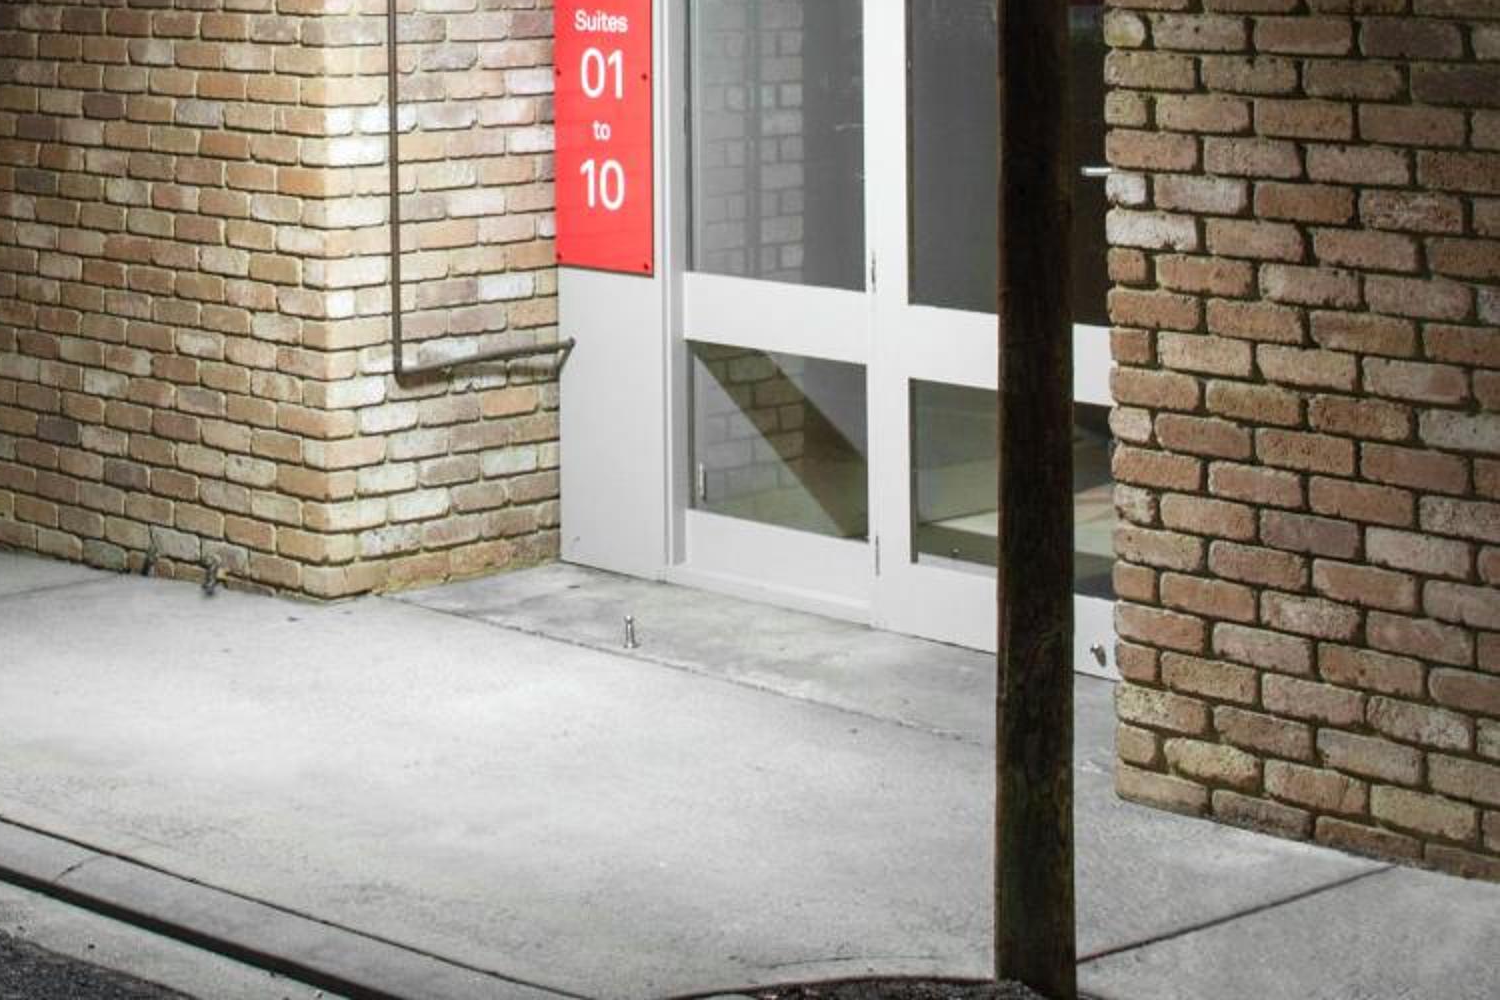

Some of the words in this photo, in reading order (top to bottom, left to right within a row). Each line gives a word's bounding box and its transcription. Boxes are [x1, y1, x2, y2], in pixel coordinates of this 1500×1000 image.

[574, 8, 629, 34] Suites
[579, 46, 625, 100] 01
[591, 119, 612, 142] to
[579, 157, 626, 212] 10
